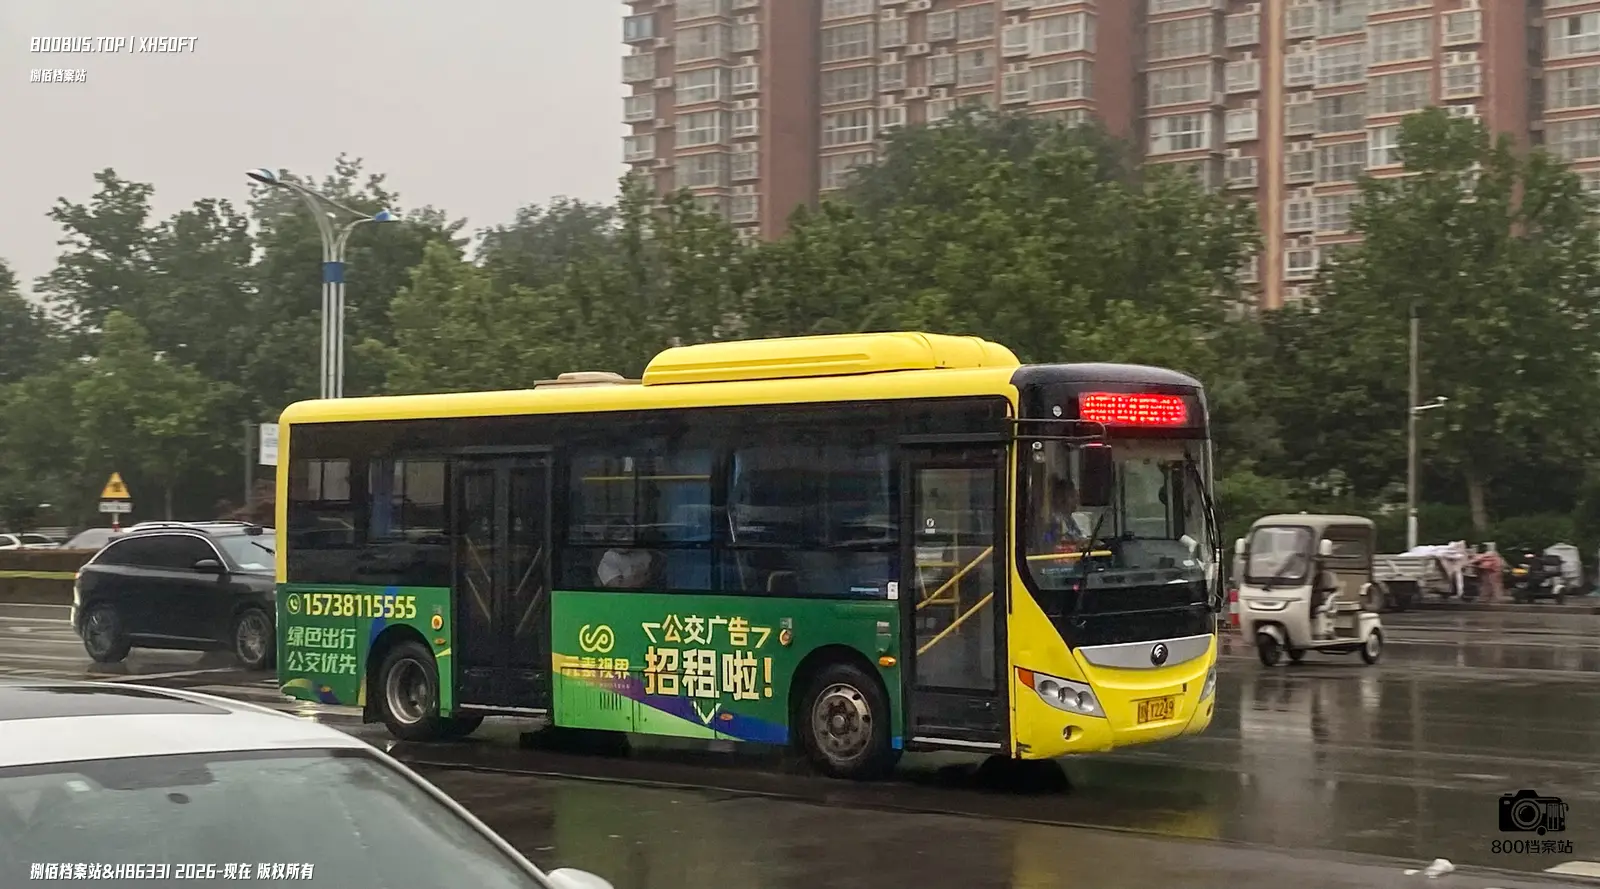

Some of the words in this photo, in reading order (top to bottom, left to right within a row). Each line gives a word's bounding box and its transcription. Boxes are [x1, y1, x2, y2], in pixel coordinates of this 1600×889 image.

[303, 593, 417, 619] 15738115555
[286, 626, 357, 649] 绿色出行
[662, 614, 750, 646] 公交广告
[287, 650, 357, 675] 公交优先
